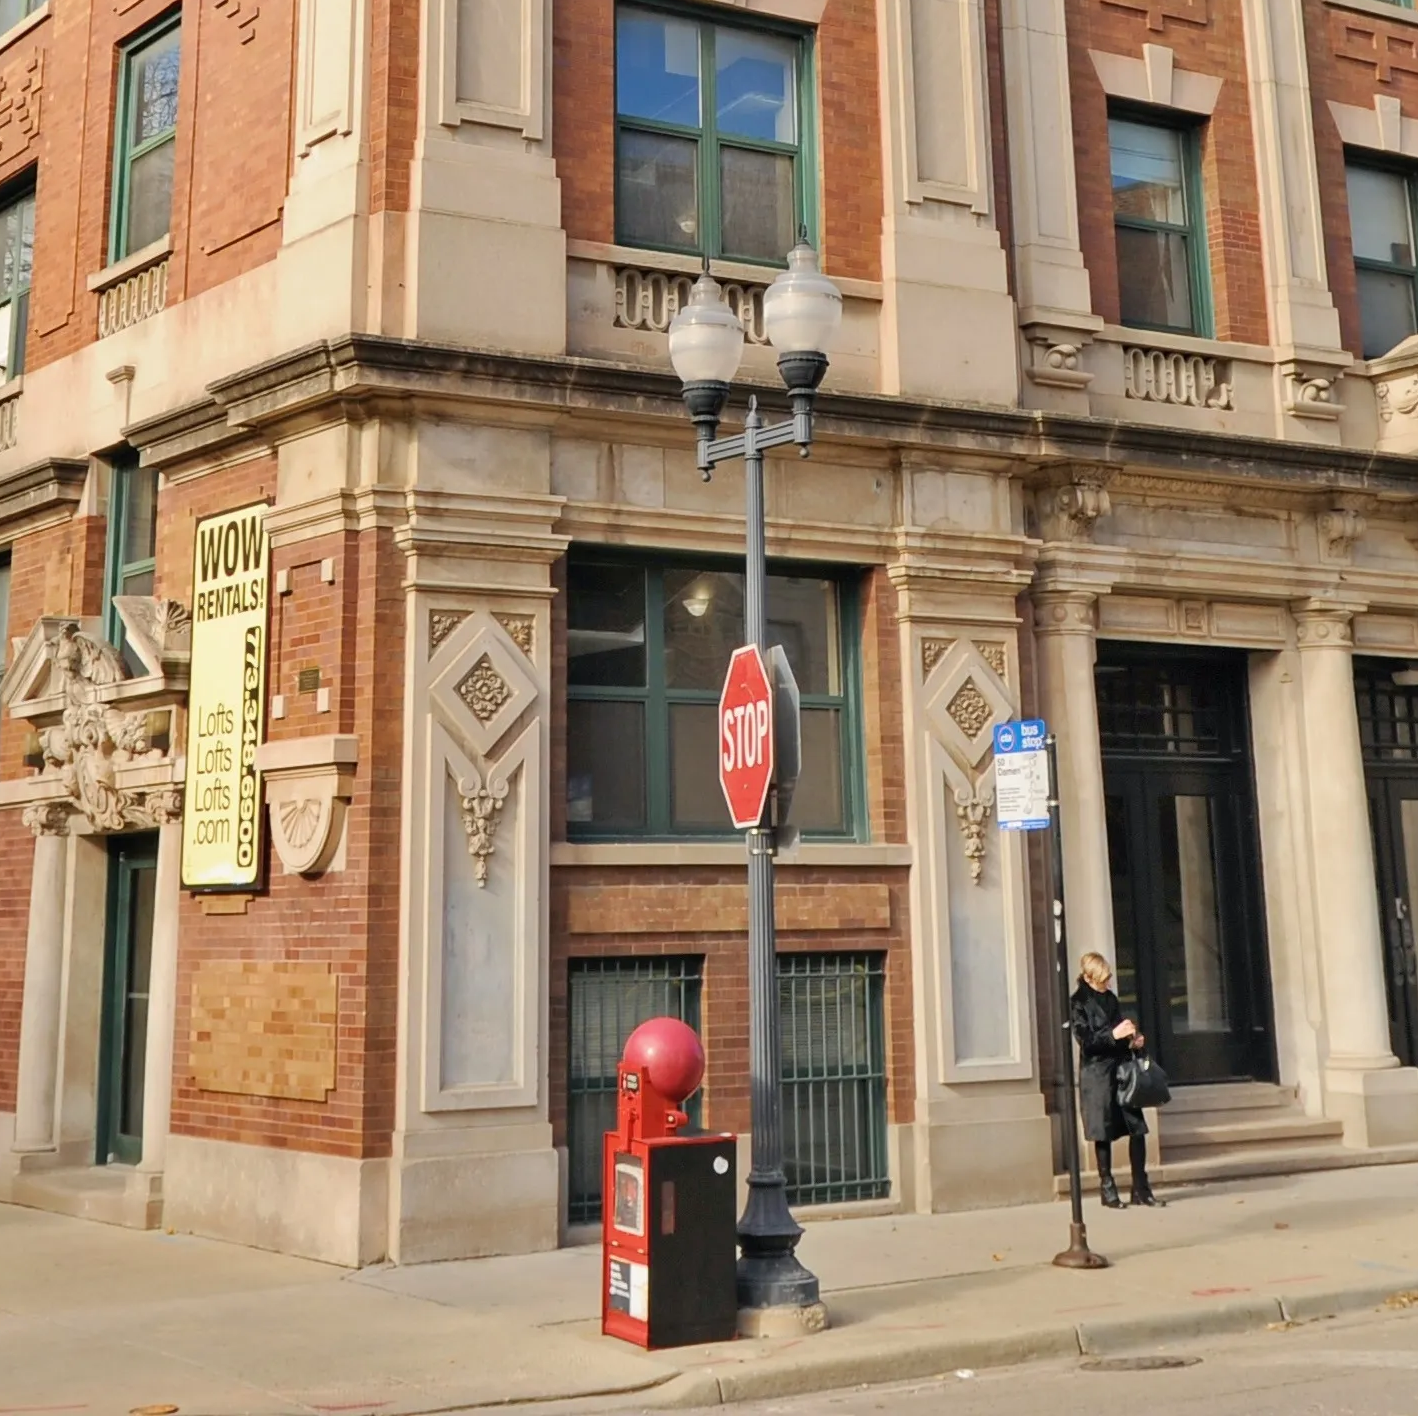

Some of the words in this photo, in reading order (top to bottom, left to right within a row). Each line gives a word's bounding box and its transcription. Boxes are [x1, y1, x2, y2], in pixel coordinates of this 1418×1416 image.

[200, 515, 263, 582] WOW
[197, 577, 264, 622] RENTALS!
[198, 702, 234, 738] Lofts
[723, 699, 768, 772] STOP
[1021, 723, 1039, 736] bus
[196, 739, 233, 775] Lofts
[238, 626, 261, 867] 773.348.6900
[1022, 736, 1043, 749] stop
[195, 777, 231, 813] Lofts
[193, 817, 230, 845] .com
